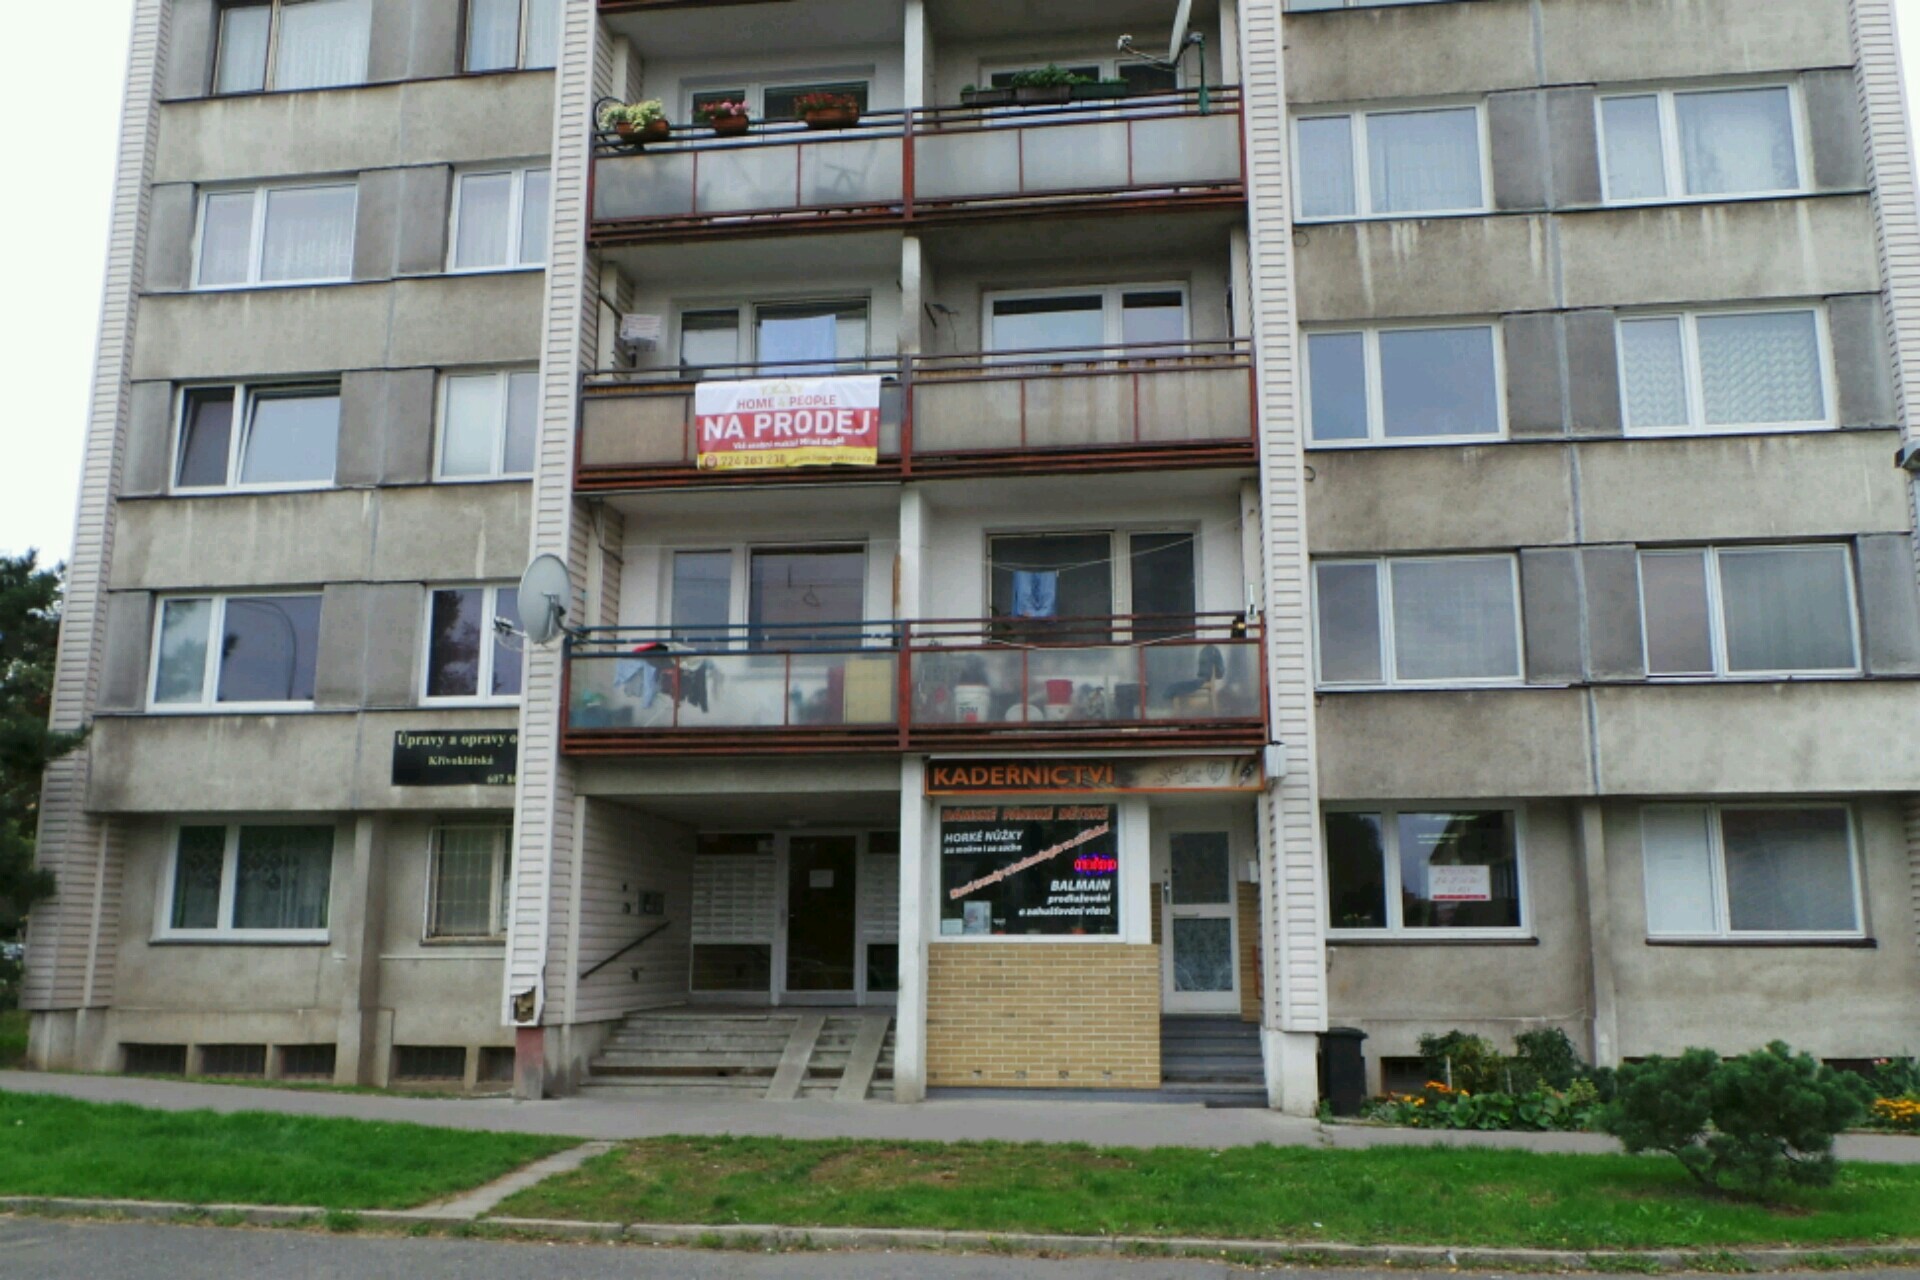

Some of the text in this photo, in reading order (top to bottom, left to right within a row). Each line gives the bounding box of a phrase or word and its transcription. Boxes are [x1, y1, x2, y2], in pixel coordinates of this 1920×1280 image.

[737, 397, 774, 409] HOME
[789, 395, 837, 406] PEOPLE
[704, 410, 871, 441] NA PRODEJ
[398, 731, 445, 749] Úpravy
[448, 735, 457, 745] a
[461, 734, 506, 748] opravy
[934, 764, 1115, 786] KADEŘNICTVÍ
[944, 829, 1024, 843] HORKÉ NŮŽKY
[1050, 880, 1111, 891] BALMAIN
